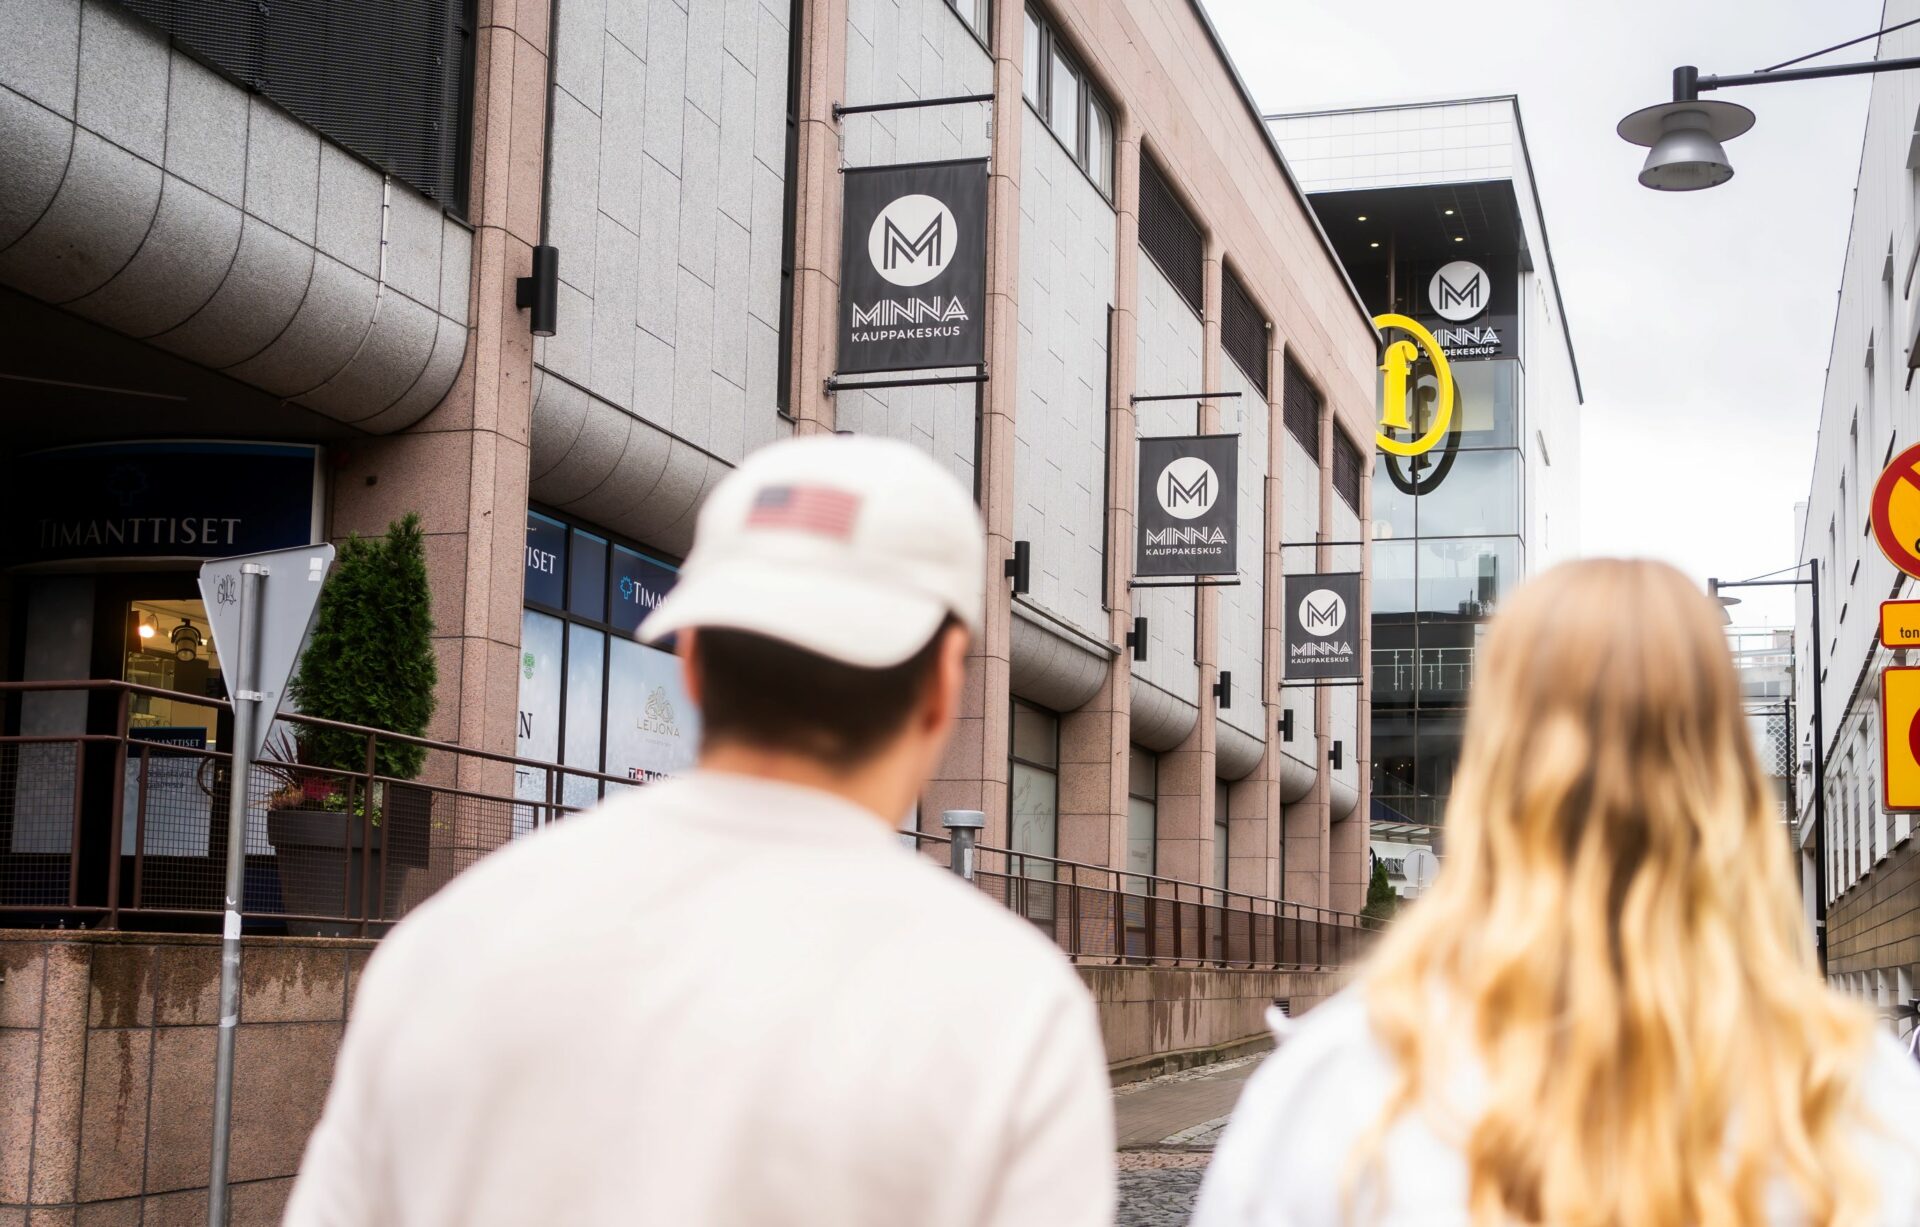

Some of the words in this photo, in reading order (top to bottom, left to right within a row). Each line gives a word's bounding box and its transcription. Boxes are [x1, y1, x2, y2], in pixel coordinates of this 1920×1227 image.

[852, 295, 970, 328] MINNA
[851, 326, 961, 342] KAUPPAKESKUS
[1423, 346, 1495, 358] VDEKESKUS
[39, 517, 242, 549] TIMANTTISET
[1146, 526, 1228, 546] MINNA
[525, 546, 557, 575] ISET
[1145, 547, 1222, 556] KAUPPAKESKUS
[633, 581, 669, 610] TIMA
[1291, 641, 1353, 657] MINNA
[1291, 656, 1350, 664] KAUPPAKESKUS
[636, 718, 680, 738] LEIJONA
